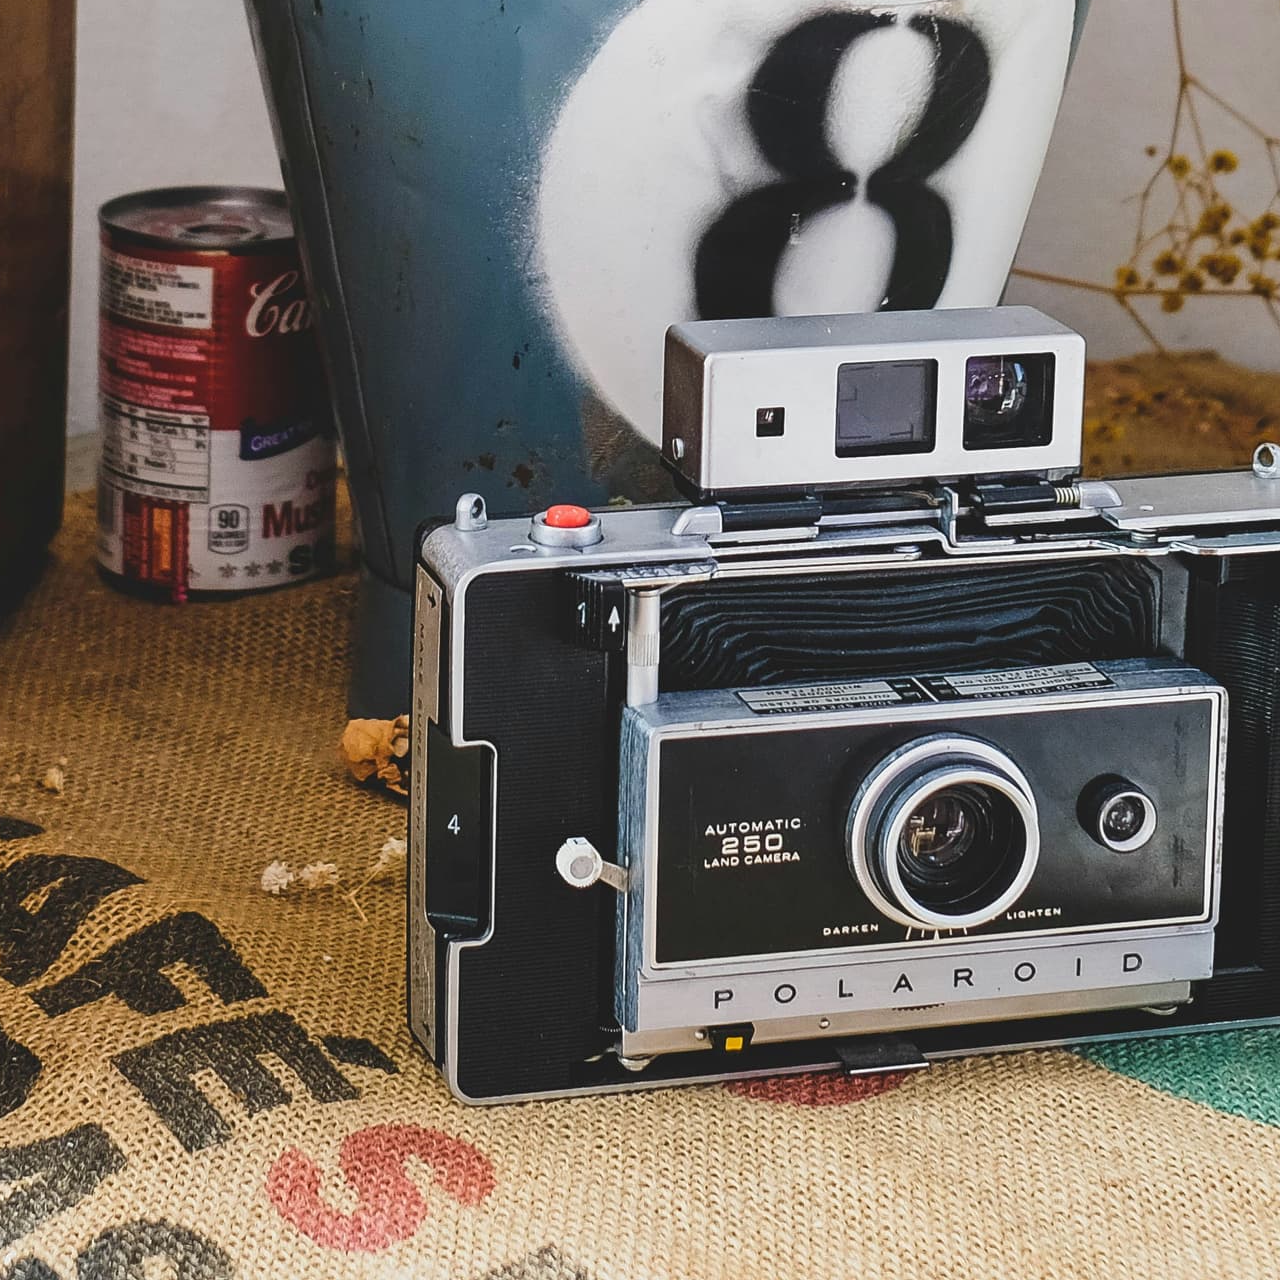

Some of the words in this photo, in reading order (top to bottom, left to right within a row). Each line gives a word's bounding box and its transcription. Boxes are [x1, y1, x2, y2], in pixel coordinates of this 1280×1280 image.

[693, 8, 991, 319] 8
[218, 509, 240, 529] 90
[447, 814, 461, 835] 4
[704, 817, 801, 837] AUTOMATIC
[721, 832, 783, 855] 250
[703, 855, 740, 870] LAND
[744, 850, 801, 866] CAMERA
[1006, 907, 1062, 921] LIGHTEN
[823, 923, 879, 937] DARKEN
[713, 952, 1144, 1010] POLAROID
